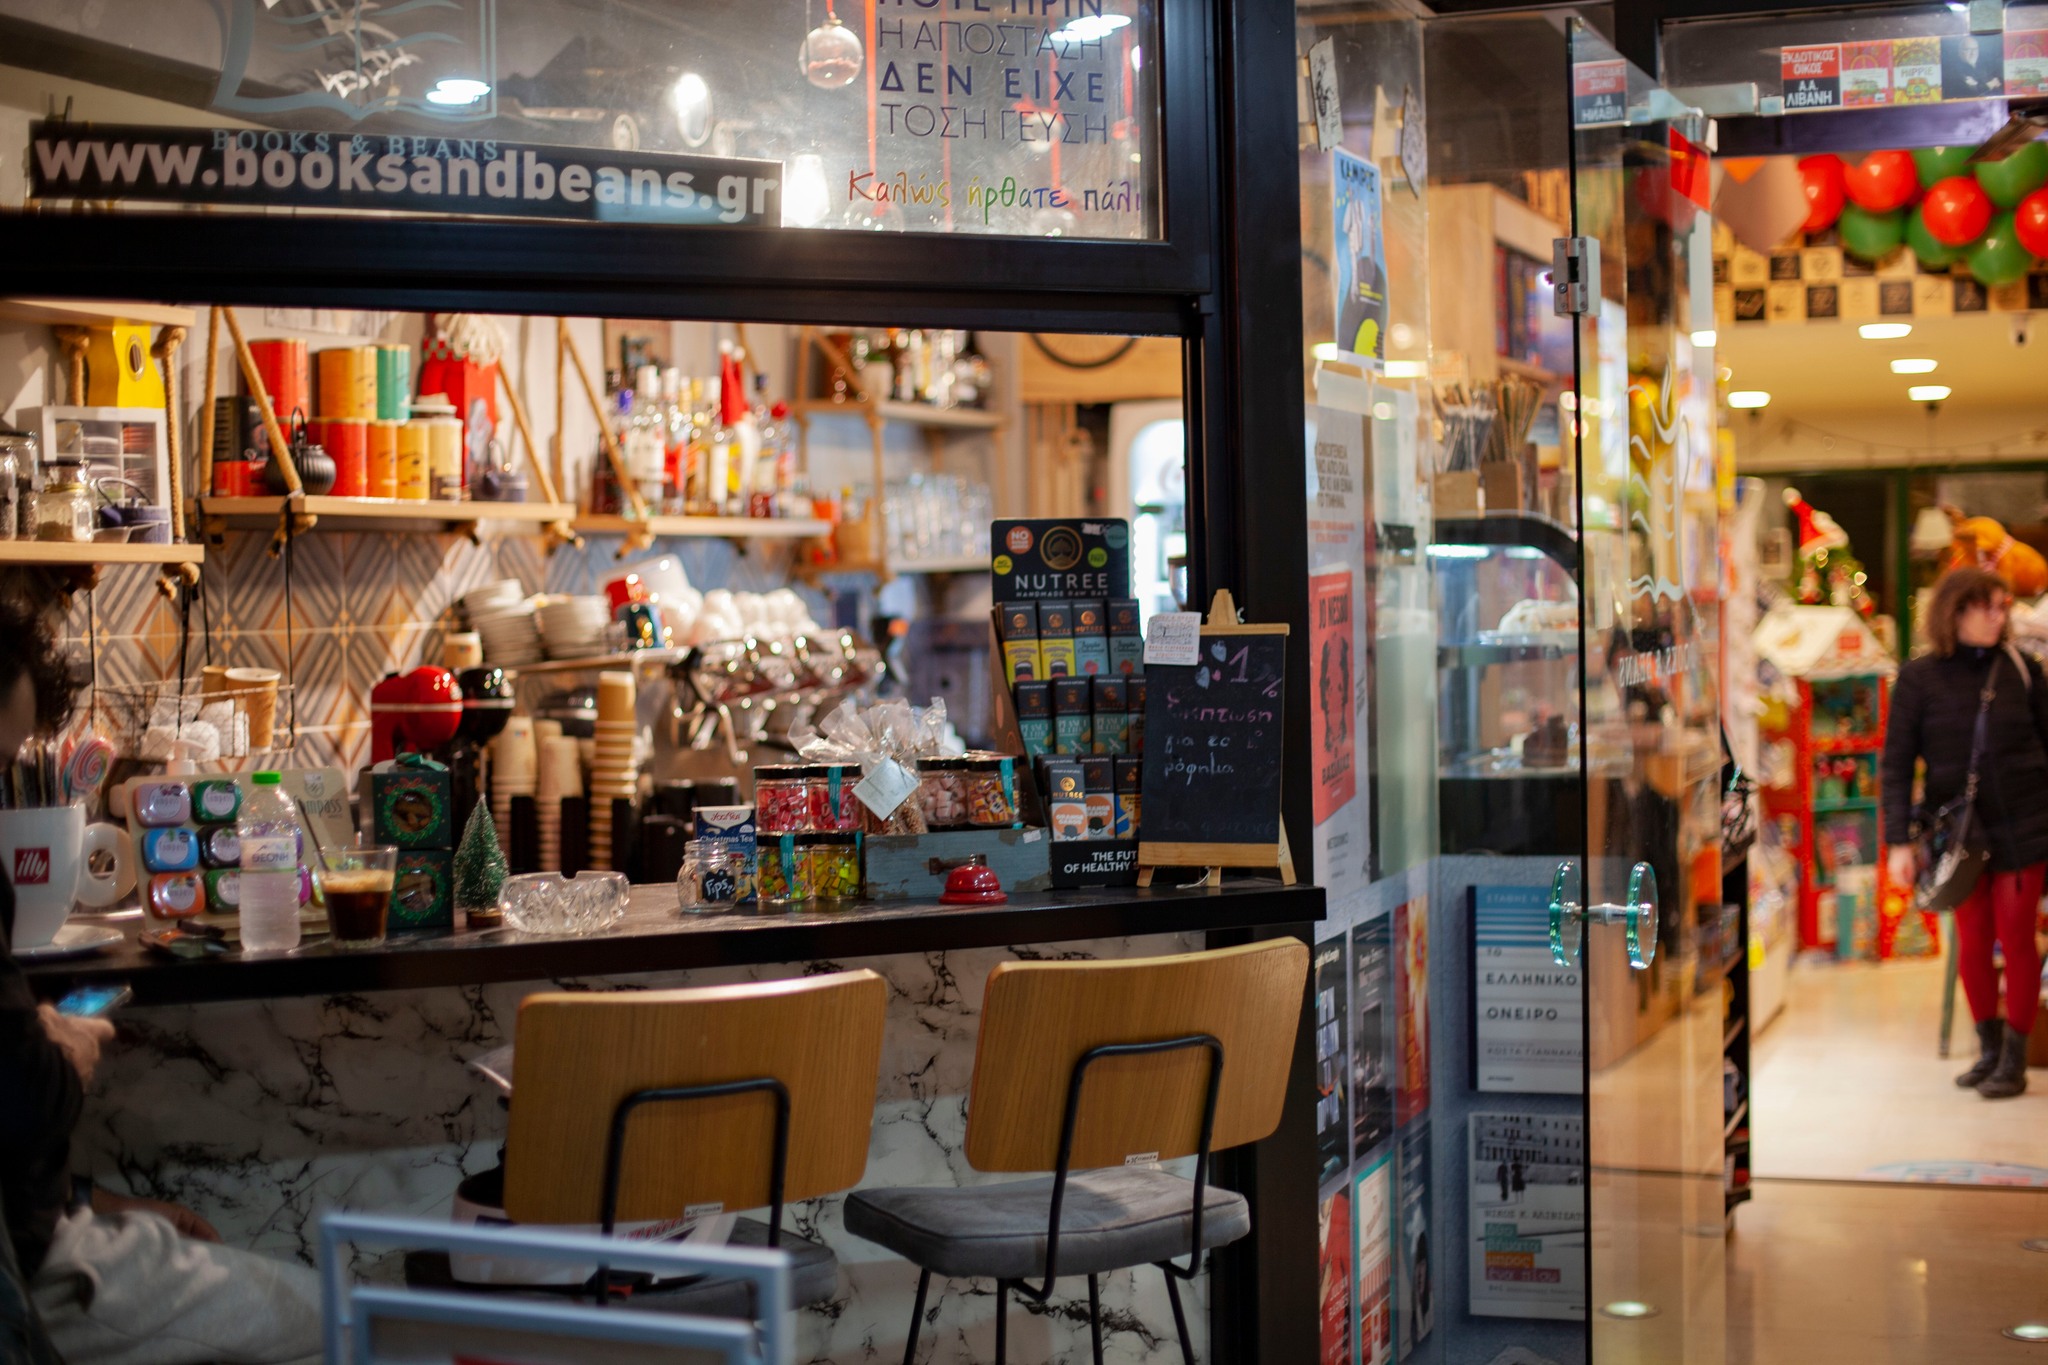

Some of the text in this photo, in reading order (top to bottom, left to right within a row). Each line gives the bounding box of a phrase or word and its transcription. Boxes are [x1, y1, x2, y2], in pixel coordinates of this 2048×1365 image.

[879, 18, 1104, 61] Η ΑΠΟΣΤΑΣΗ
[1793, 62, 1823, 75] ΟΙΚΟΣ
[880, 61, 1105, 103] ΔΕΝ ΕΙΧΕ
[1785, 90, 1833, 108] ΛΙΒΑΝΗ
[880, 104, 1108, 145] ΤΟΣΗ ΓΕΥΣΗ
[212, 129, 499, 161] BOOKS & BEANS
[35, 135, 779, 224] www.booksandbeans.gr
[968, 176, 1069, 225] ήρθατε
[1014, 573, 1109, 591] NUTREE
[16, 852, 48, 882] illy
[1064, 861, 1130, 873] OF HEALTHY
[1092, 851, 1114, 862] THE
[1486, 973, 1577, 987] ΕΛΛΗΝΙΚΟ
[1486, 1006, 1558, 1021] ΟΝΕΙΡΟ
